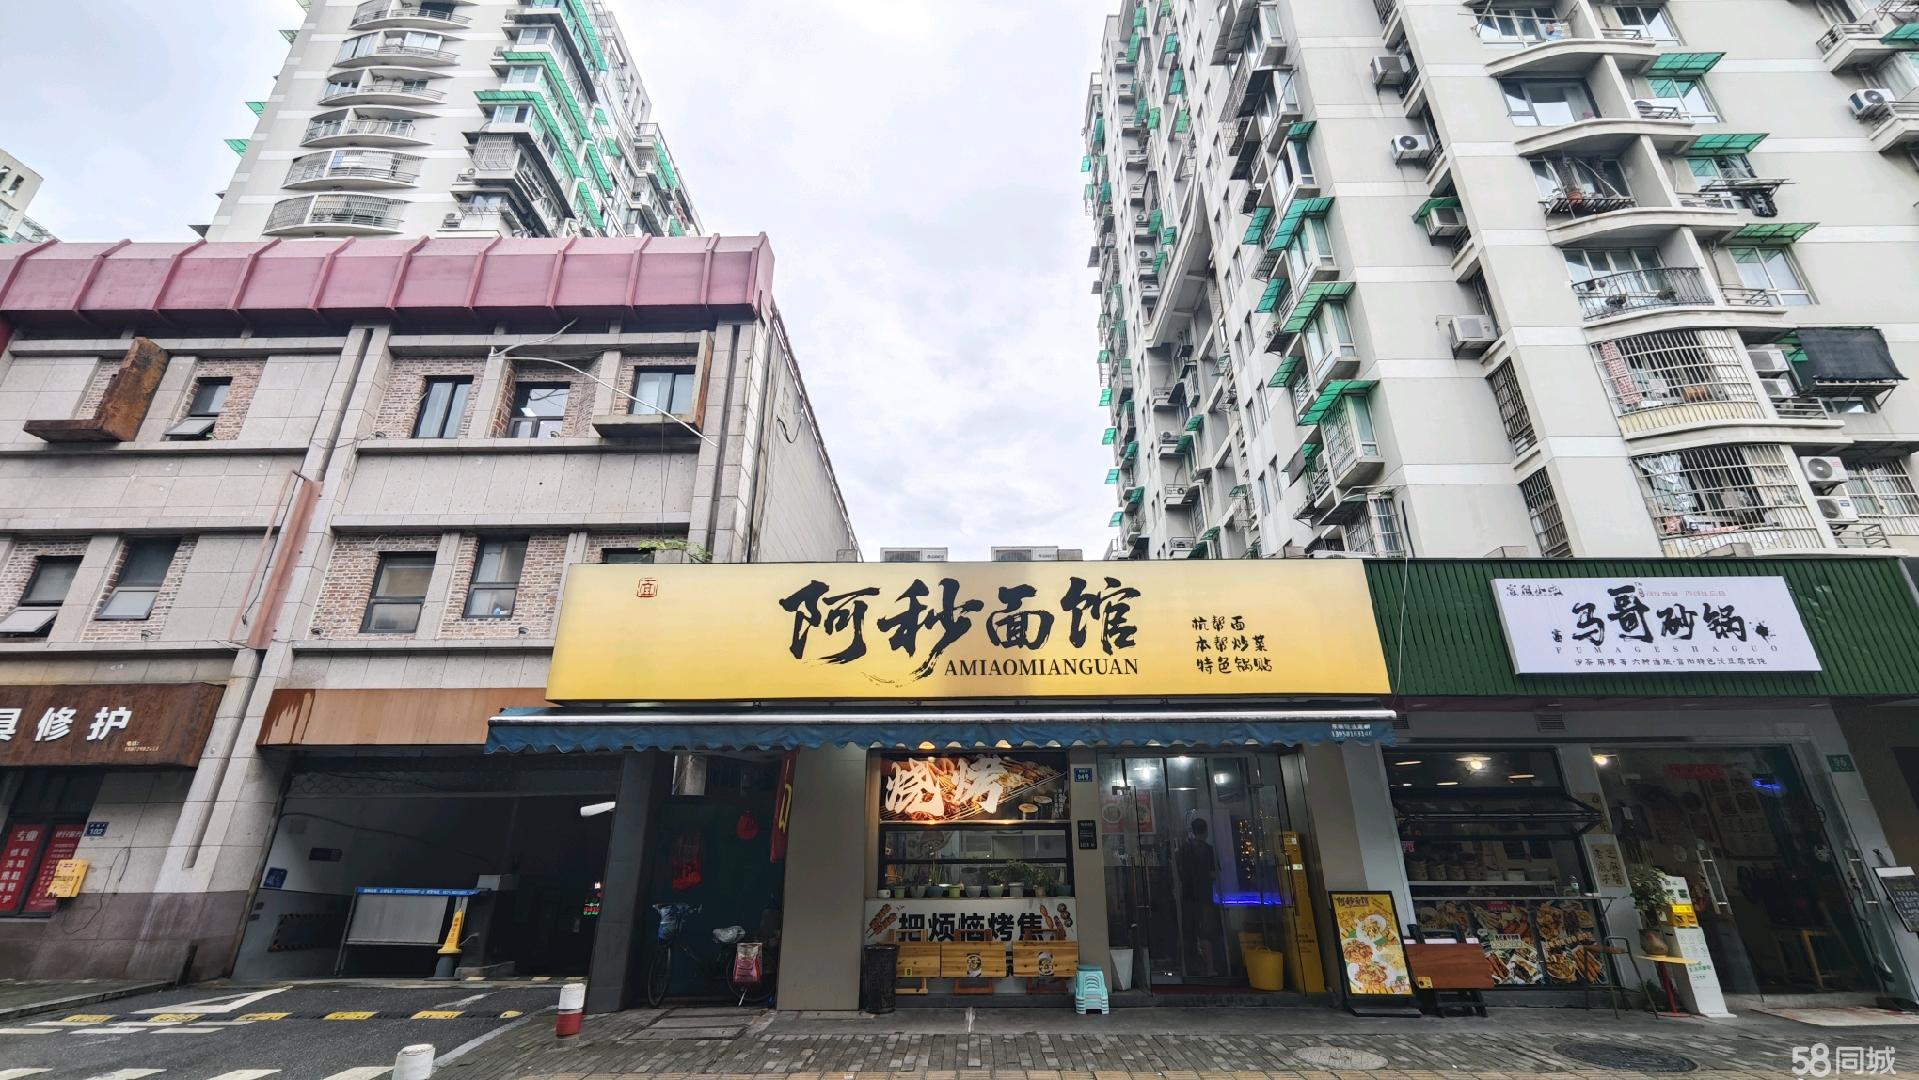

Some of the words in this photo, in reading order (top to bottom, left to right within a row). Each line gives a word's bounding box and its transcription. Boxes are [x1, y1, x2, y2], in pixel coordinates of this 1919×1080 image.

[1192, 614, 1246, 631] 杭帮面
[1196, 634, 1268, 652] 本帮炒菜
[944, 657, 1140, 677] AMIAOMIANGUAN
[1196, 656, 1272, 675] 特色锅贴
